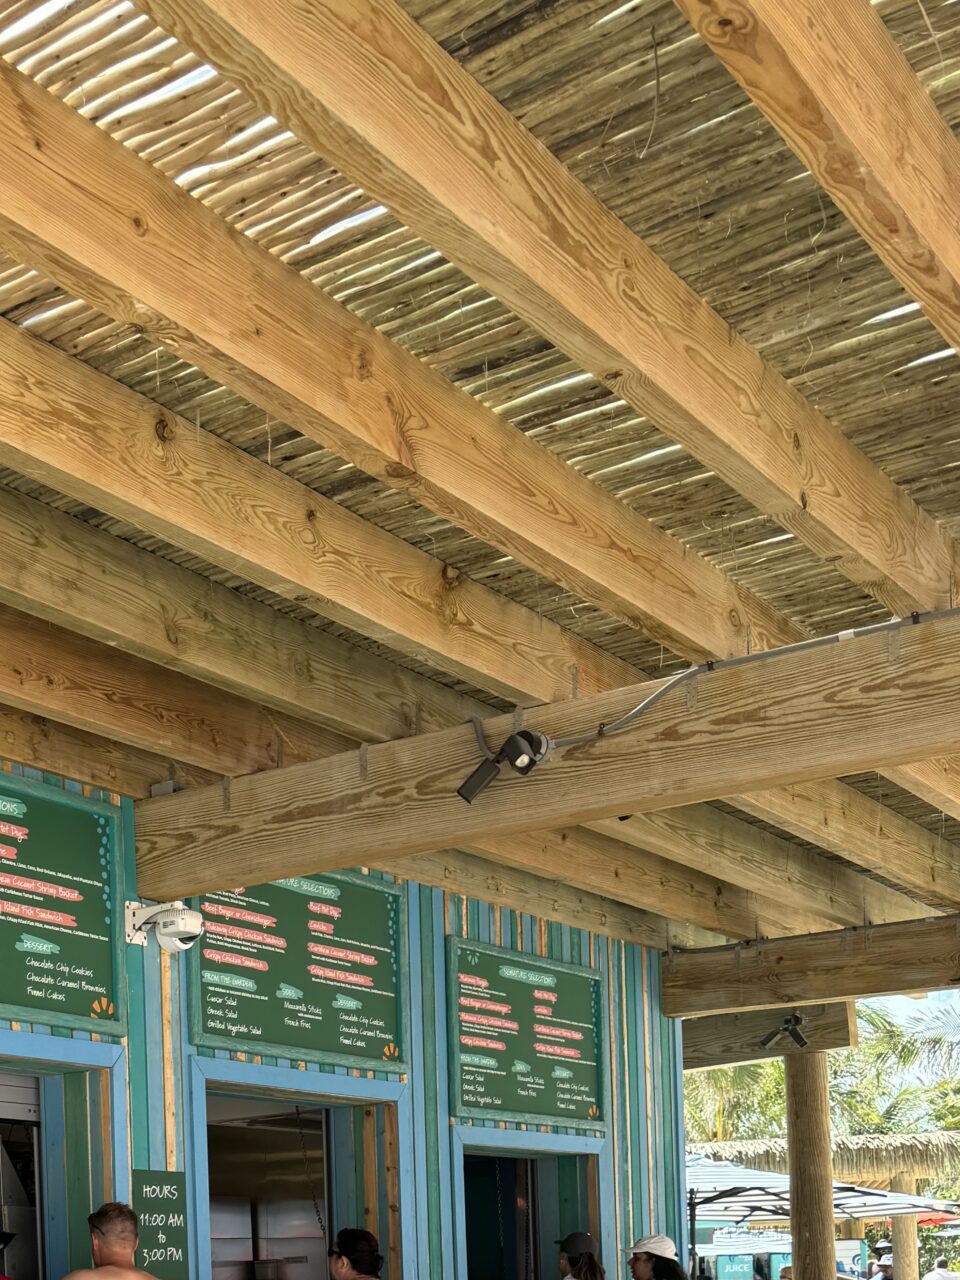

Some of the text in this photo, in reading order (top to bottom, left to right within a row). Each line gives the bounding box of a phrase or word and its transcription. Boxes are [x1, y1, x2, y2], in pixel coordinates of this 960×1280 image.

[300, 881, 335, 897] SELECTIONS
[23, 939, 52, 952] DESSERT
[26, 957, 93, 977] Chocolate Chip Cookies
[27, 972, 106, 994] Chocolate Caramel Brownies
[47, 990, 65, 1001] Cakes
[143, 1185, 178, 1199] HOURS
[140, 1213, 184, 1227] 11:00 AM
[158, 1230, 166, 1243] to
[143, 1248, 182, 1266] 3:00 PM
[724, 1264, 749, 1272] JUICE
